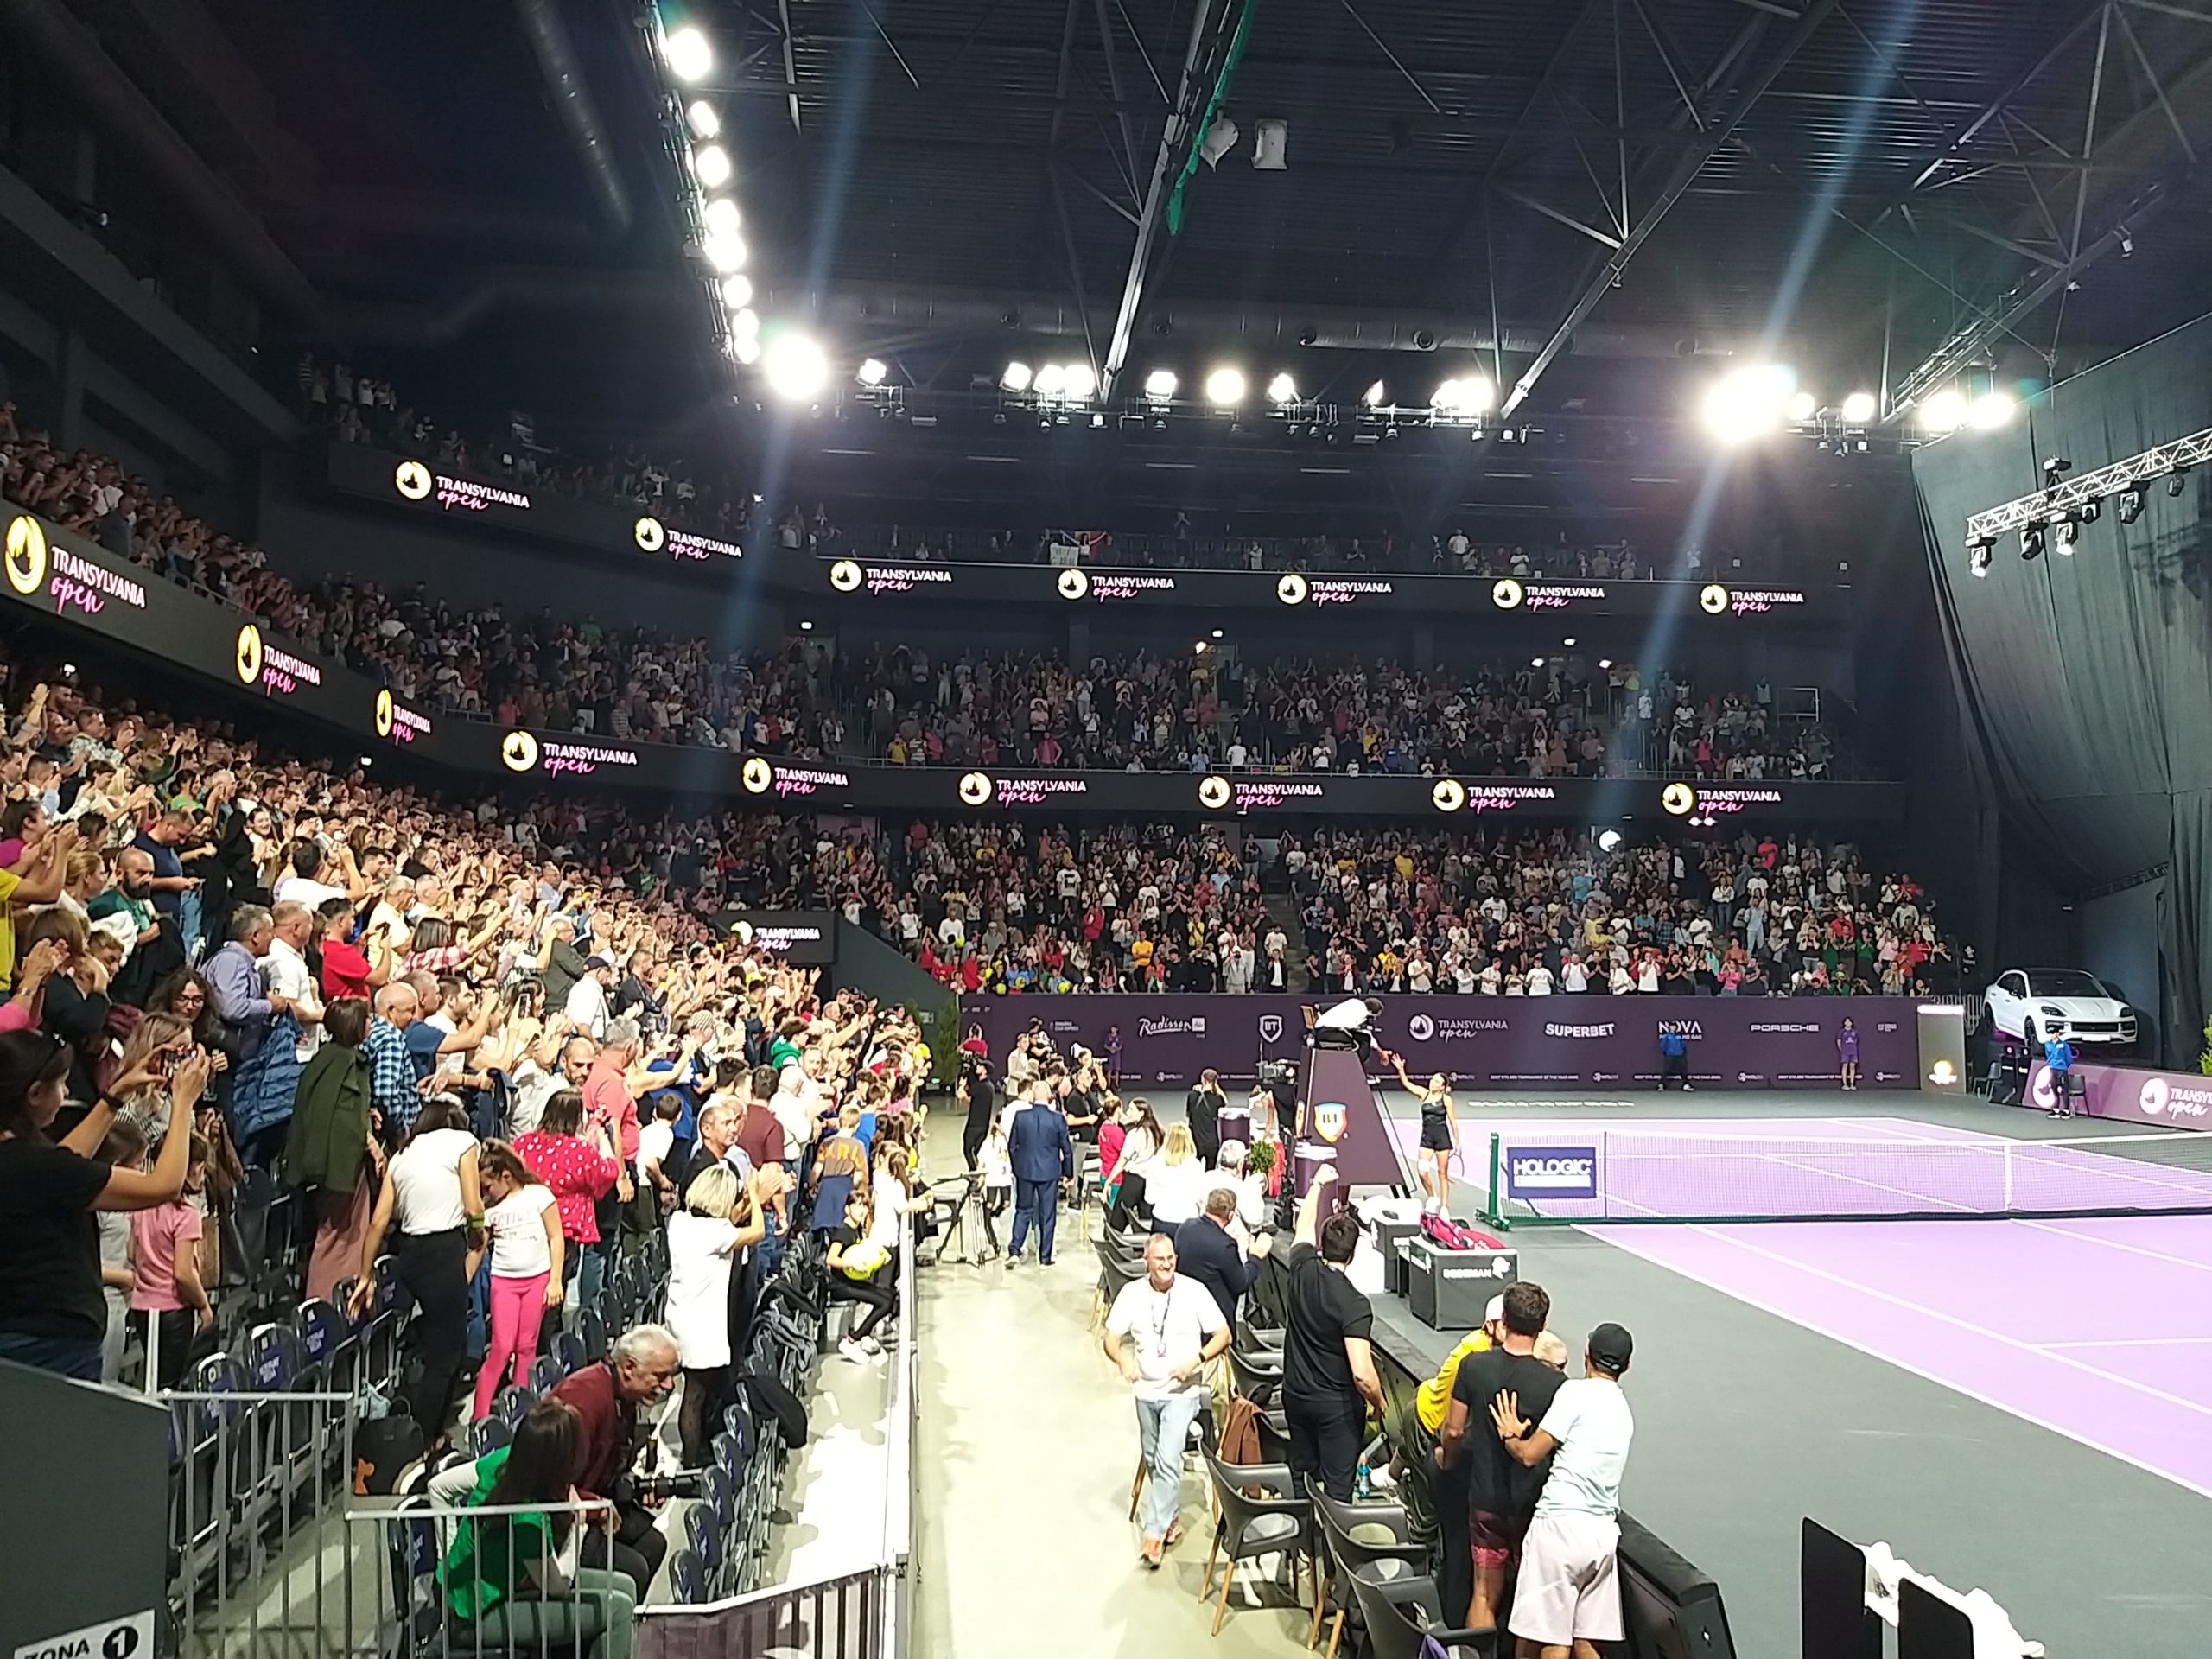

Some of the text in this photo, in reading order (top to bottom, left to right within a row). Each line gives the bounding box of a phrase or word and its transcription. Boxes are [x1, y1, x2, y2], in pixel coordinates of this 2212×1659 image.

[436, 476, 530, 508] TRANSYLVANIA
[667, 530, 742, 557] TRANSYLVANIA
[51, 546, 145, 608] TRANSYLVANIA
[867, 569, 951, 582] TRANSYLVANIA
[1092, 576, 1174, 588] TRANSYLVANIA
[1311, 582, 1391, 593] TRANSYLVANIA
[1525, 587, 1605, 597] TRANSYLVANIA
[1730, 592, 1803, 602] TRANSYLVANIA
[263, 645, 320, 685] TRANSYLVANIA
[543, 743, 638, 765] TRANSYLVANIA
[775, 768, 848, 785] TRANSYLVANIA
[996, 780, 1086, 791] TRANSYLVANIA
[1235, 784, 1322, 795] TRANSYLVANIA
[1468, 787, 1554, 798] TRANSYLVANIA
[1696, 791, 1780, 802] TRANSYLVANIA
[1139, 1016, 1192, 1037] Radisson
[1438, 1020, 1508, 1029] TRANSYLVANIA
[1545, 1023, 1615, 1038] SUPERBET
[1751, 1024, 1820, 1033] PORSCHE
[1439, 1027, 1477, 1043] open
[1513, 1158, 1592, 1176] HOLOGIC
[24, 1639, 90, 1659] ONA
